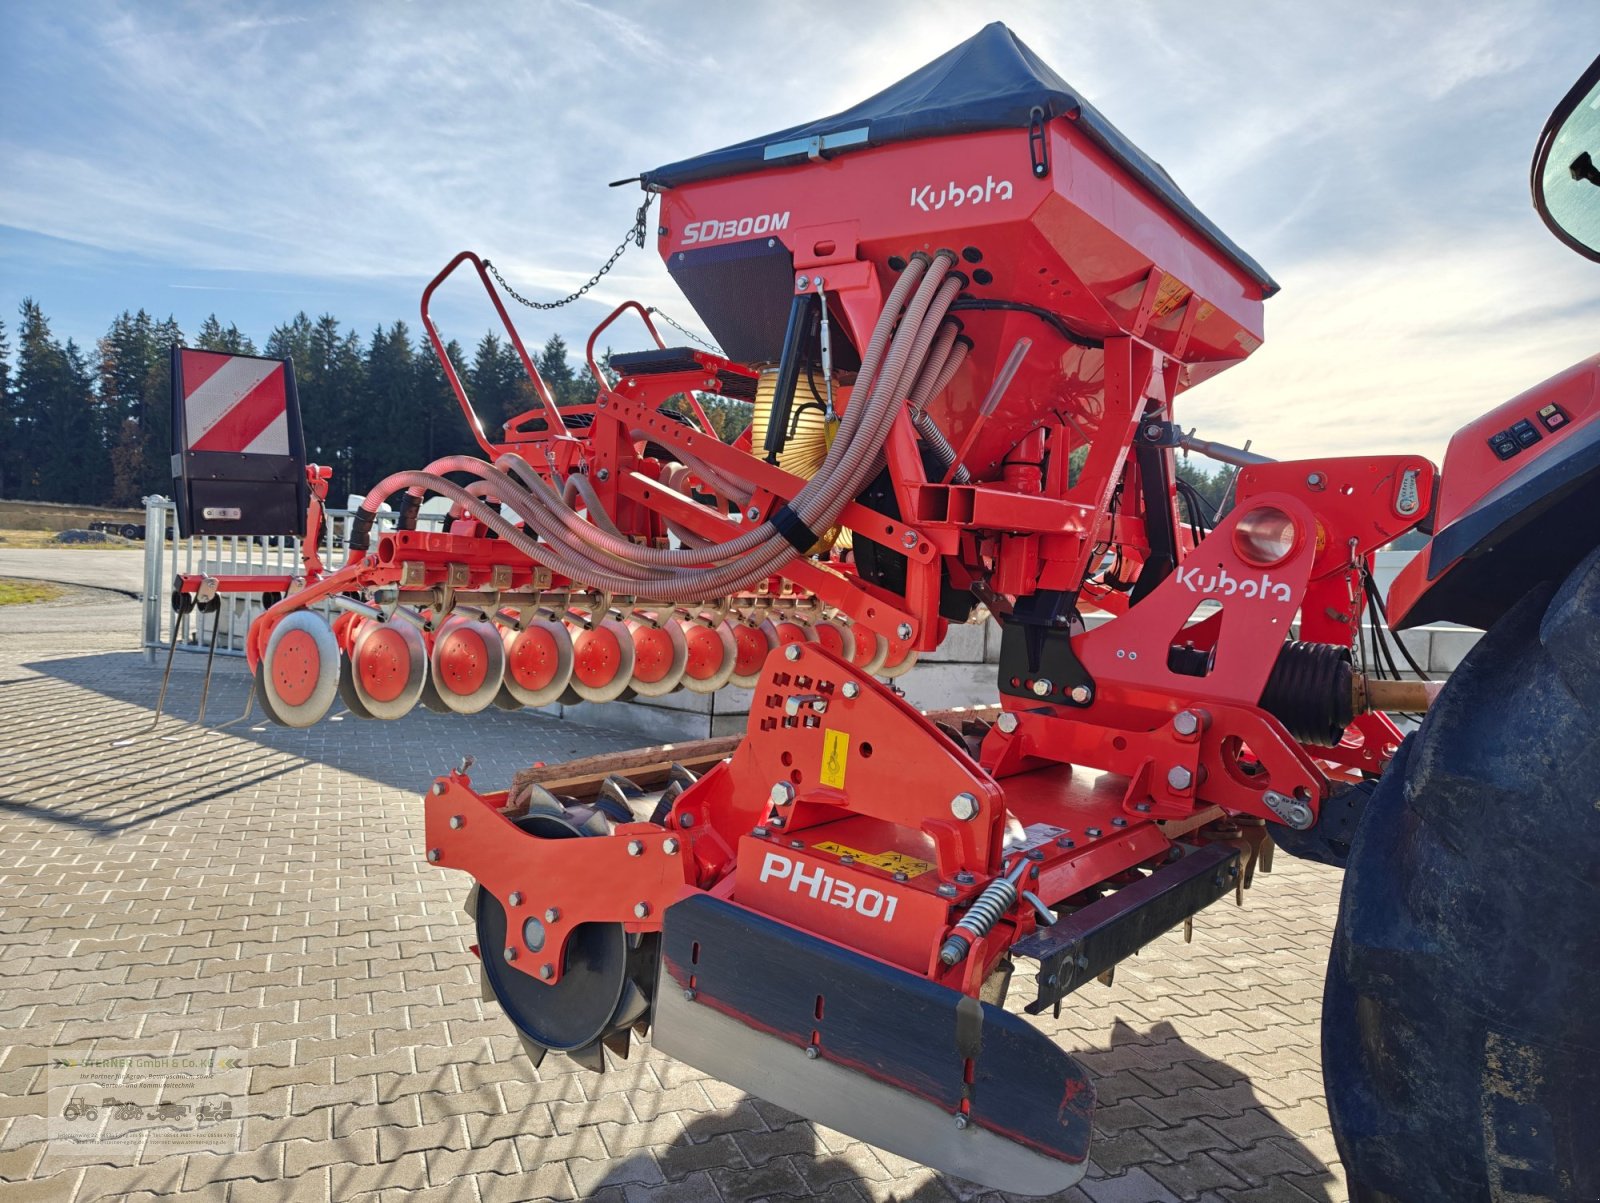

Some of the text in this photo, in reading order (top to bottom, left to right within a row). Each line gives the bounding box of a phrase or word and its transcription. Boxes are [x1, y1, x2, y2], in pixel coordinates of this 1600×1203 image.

[911, 175, 1013, 212] Kubota
[681, 211, 791, 245] SD1300M
[1176, 566, 1292, 603] Kubota
[759, 852, 899, 923] PH1301
